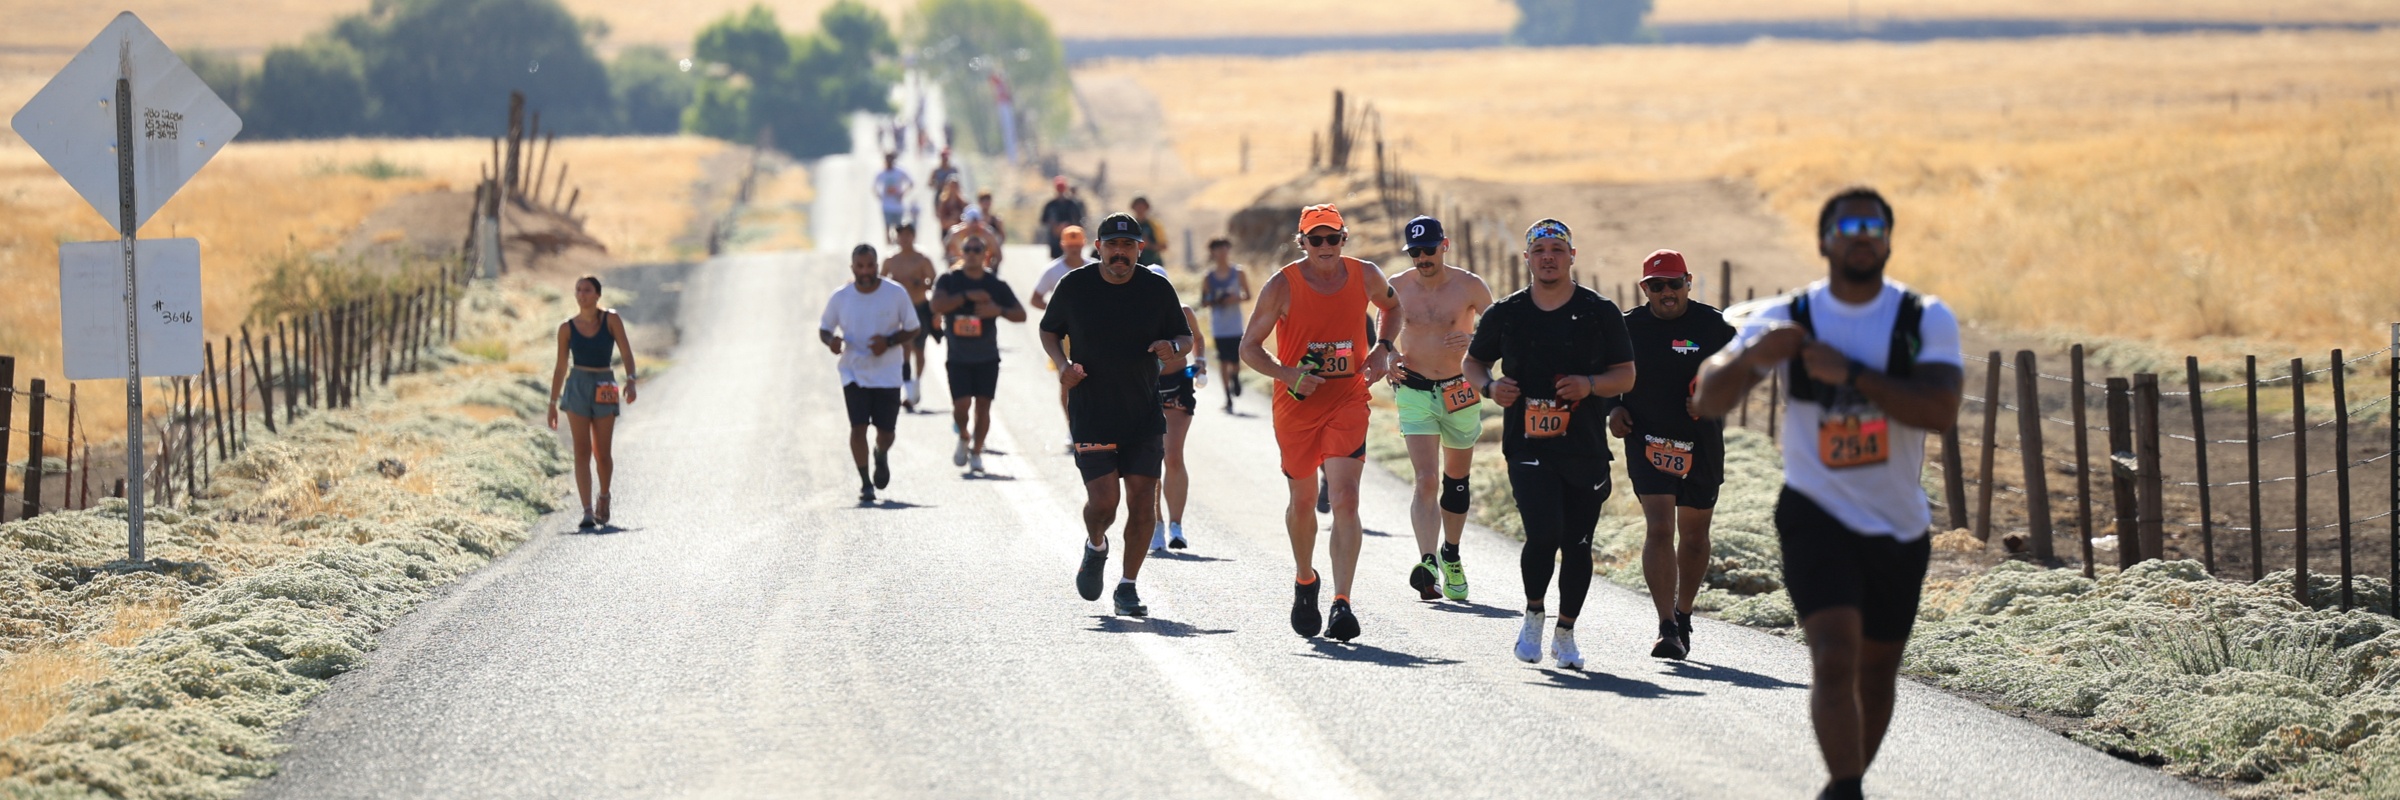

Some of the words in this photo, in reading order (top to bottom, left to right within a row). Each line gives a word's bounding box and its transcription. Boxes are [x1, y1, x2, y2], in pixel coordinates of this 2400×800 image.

[1411, 224, 1425, 239] D
[1320, 356, 1348, 373] 30
[1449, 386, 1476, 407] 154
[1529, 414, 1562, 433] 140
[1652, 450, 1685, 471] 578
